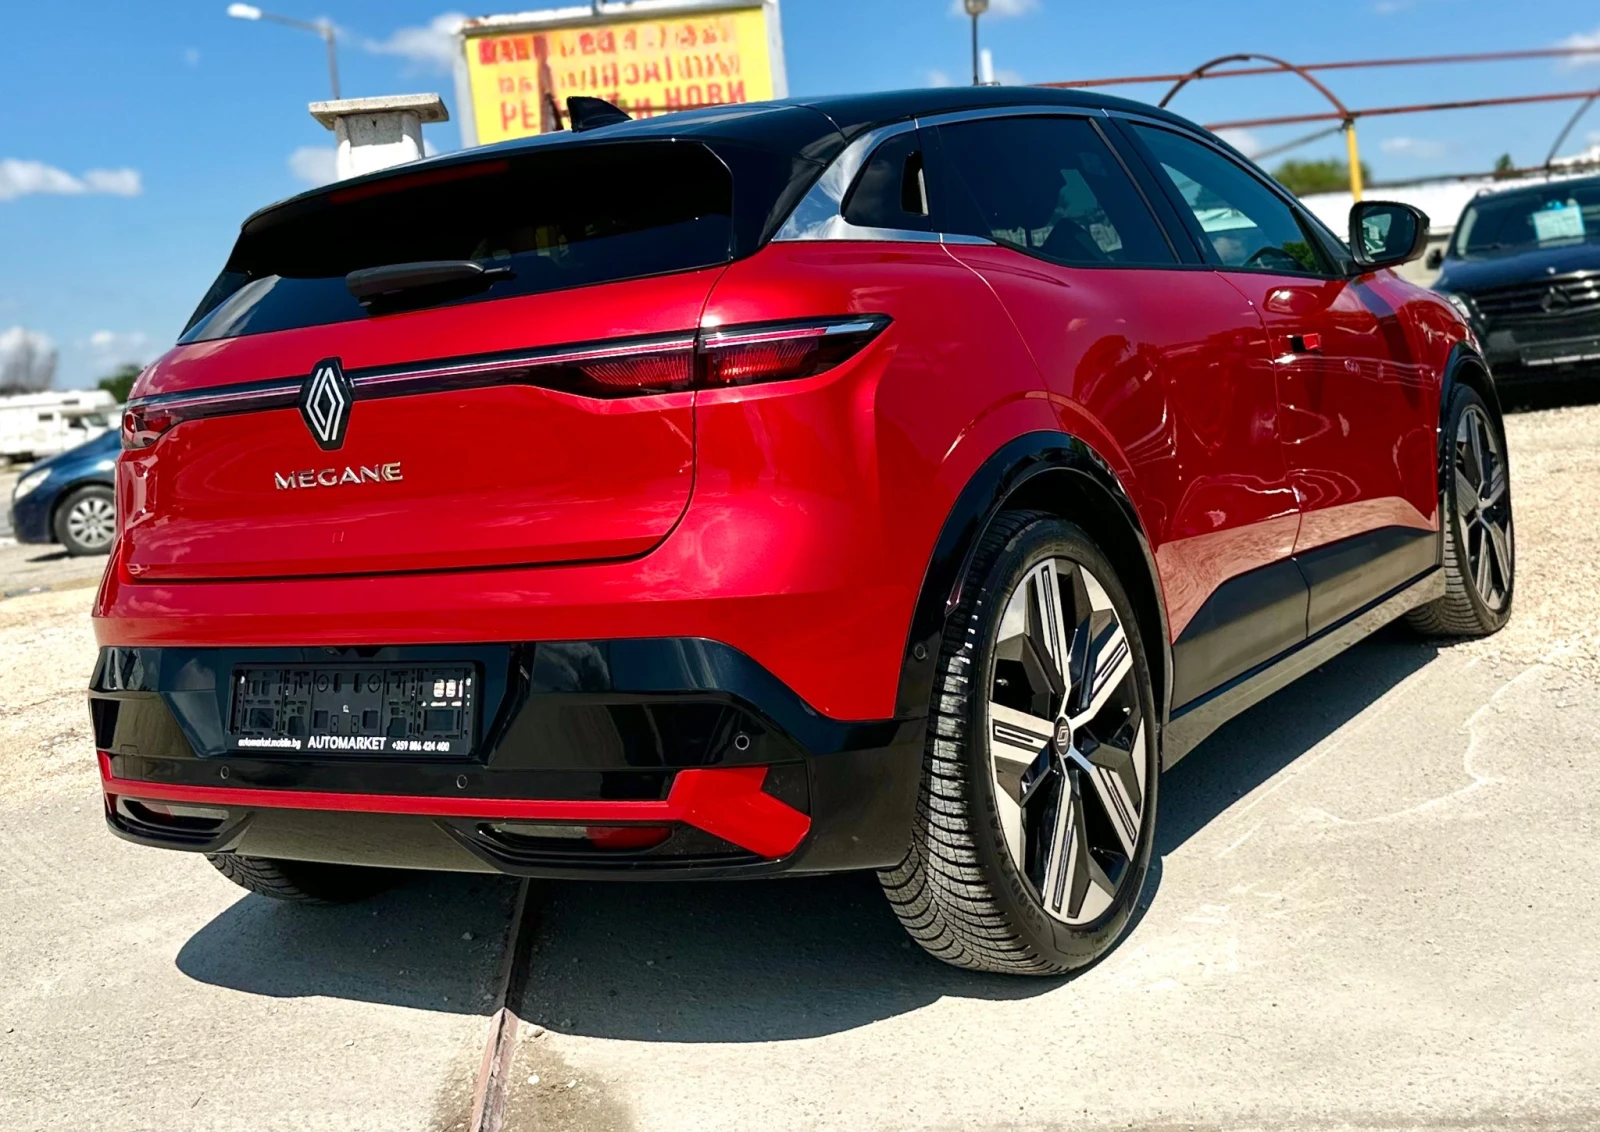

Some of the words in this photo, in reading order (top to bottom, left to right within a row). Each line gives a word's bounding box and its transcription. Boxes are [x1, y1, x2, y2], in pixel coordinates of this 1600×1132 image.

[274, 461, 404, 490] MEGANE
[307, 736, 387, 751] AUTOMARKET
[392, 740, 408, 751] +359
[422, 741, 436, 751] 424
[436, 741, 450, 752] 400
